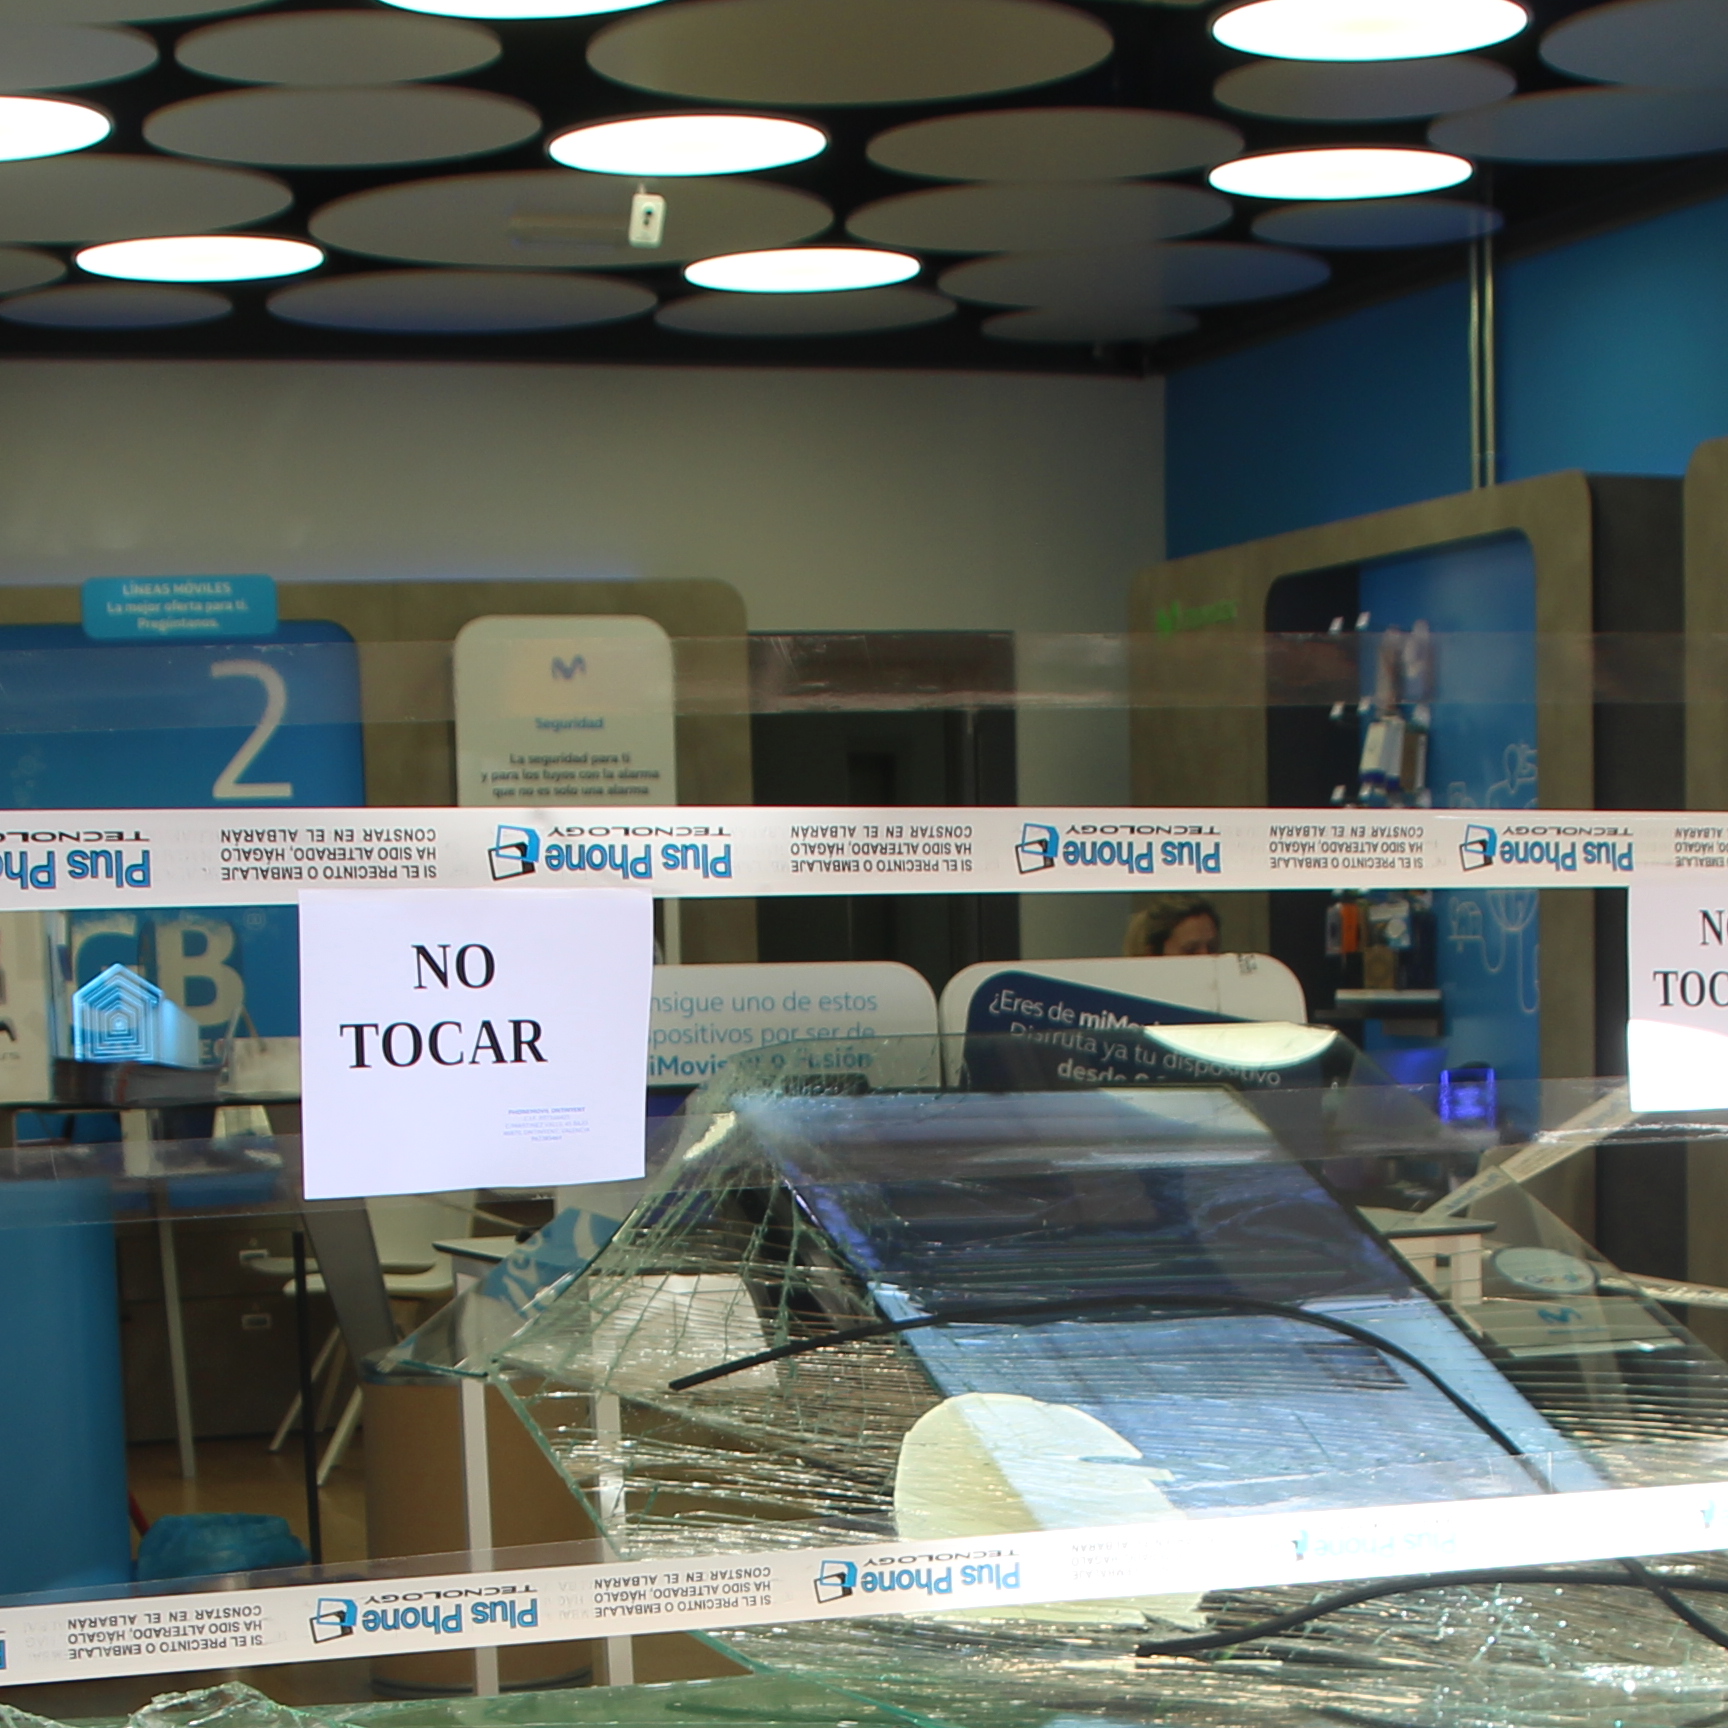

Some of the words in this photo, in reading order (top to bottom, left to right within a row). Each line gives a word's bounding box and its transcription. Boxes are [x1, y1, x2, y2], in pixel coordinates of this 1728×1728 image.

[123, 580, 170, 595] LÍNEAS
[174, 578, 232, 594] MÓVILES
[211, 659, 294, 800] 2
[535, 716, 604, 732] Seguridad
[548, 826, 731, 837] TECNOLOGY
[544, 843, 654, 880] Phone
[663, 843, 733, 879] Plus
[411, 943, 496, 990] NO
[732, 995, 775, 1012] uno
[783, 992, 811, 1012] de
[818, 992, 877, 1012] estos
[988, 989, 1044, 1018] ¿Eres
[1048, 1001, 1076, 1024] de
[340, 1019, 548, 1069] TOCAR
